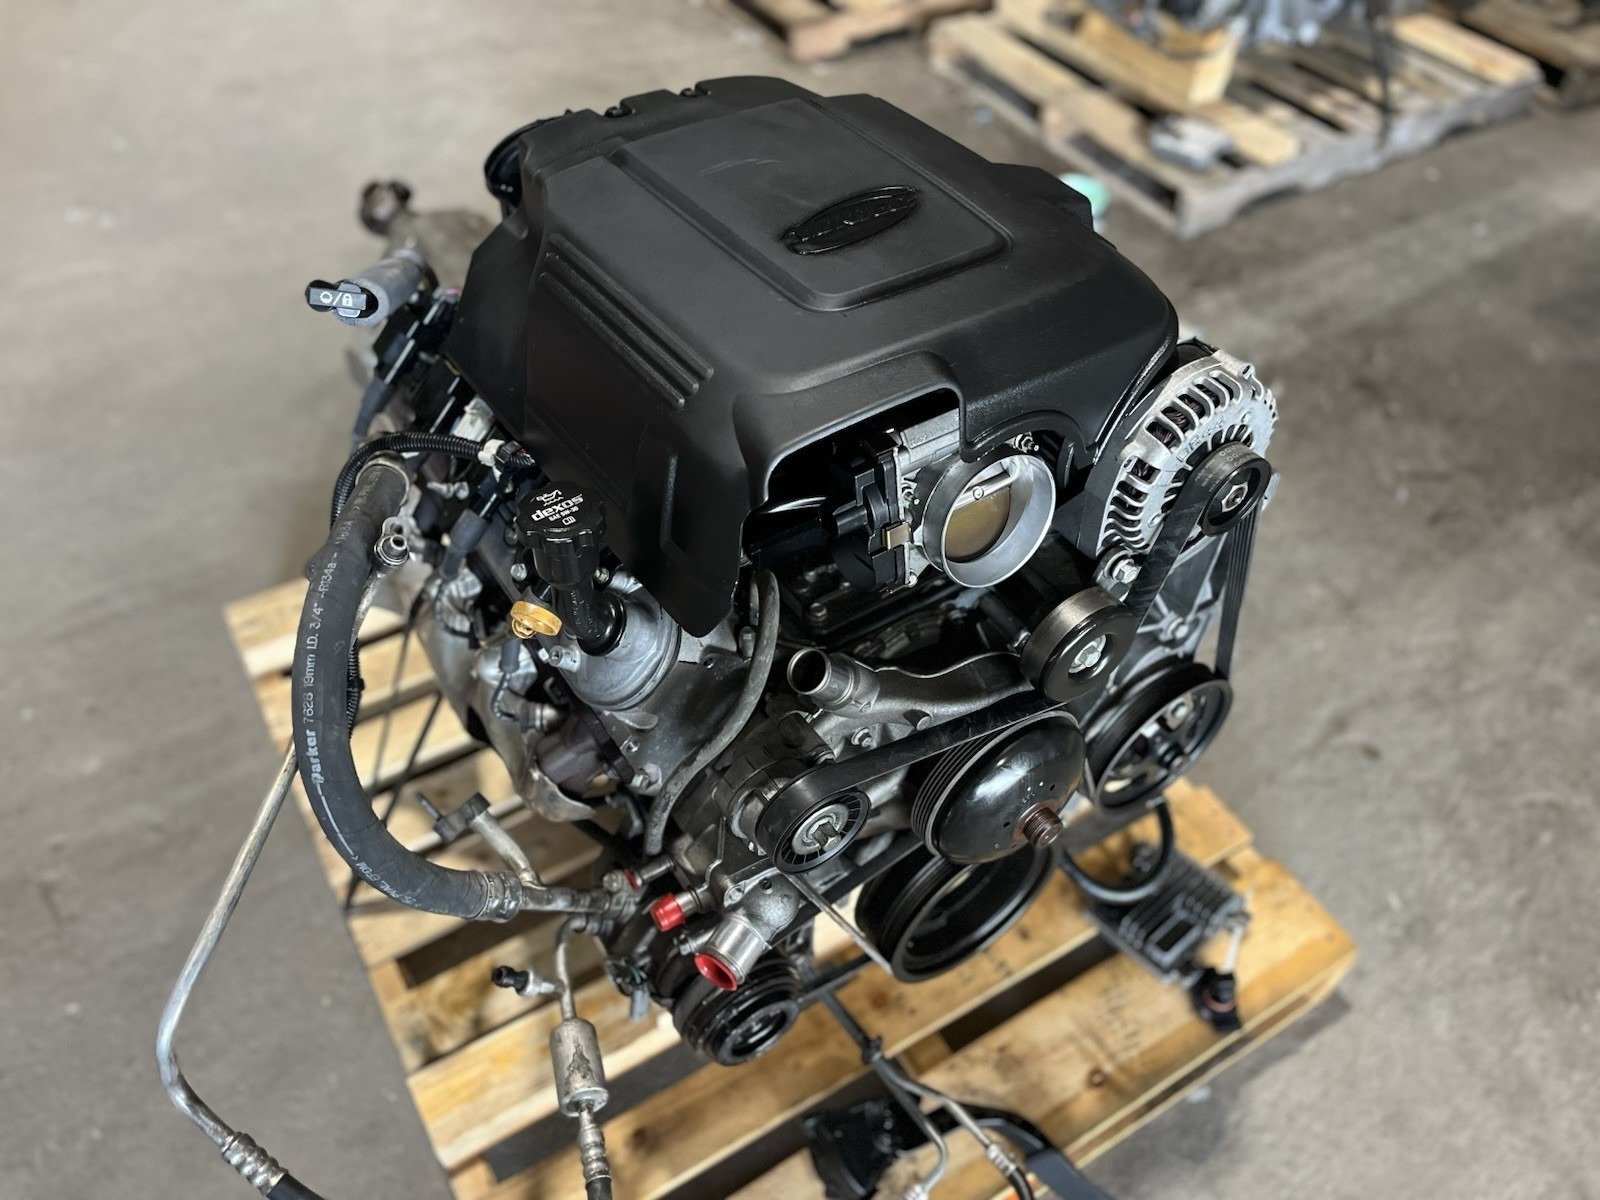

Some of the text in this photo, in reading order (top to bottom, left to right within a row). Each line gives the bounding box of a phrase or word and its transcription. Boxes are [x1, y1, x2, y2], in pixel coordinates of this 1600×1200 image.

[531, 493, 584, 521] dexos
[303, 654, 316, 687] 19mm
[303, 692, 314, 724] 7628
[305, 728, 325, 784] Parker
